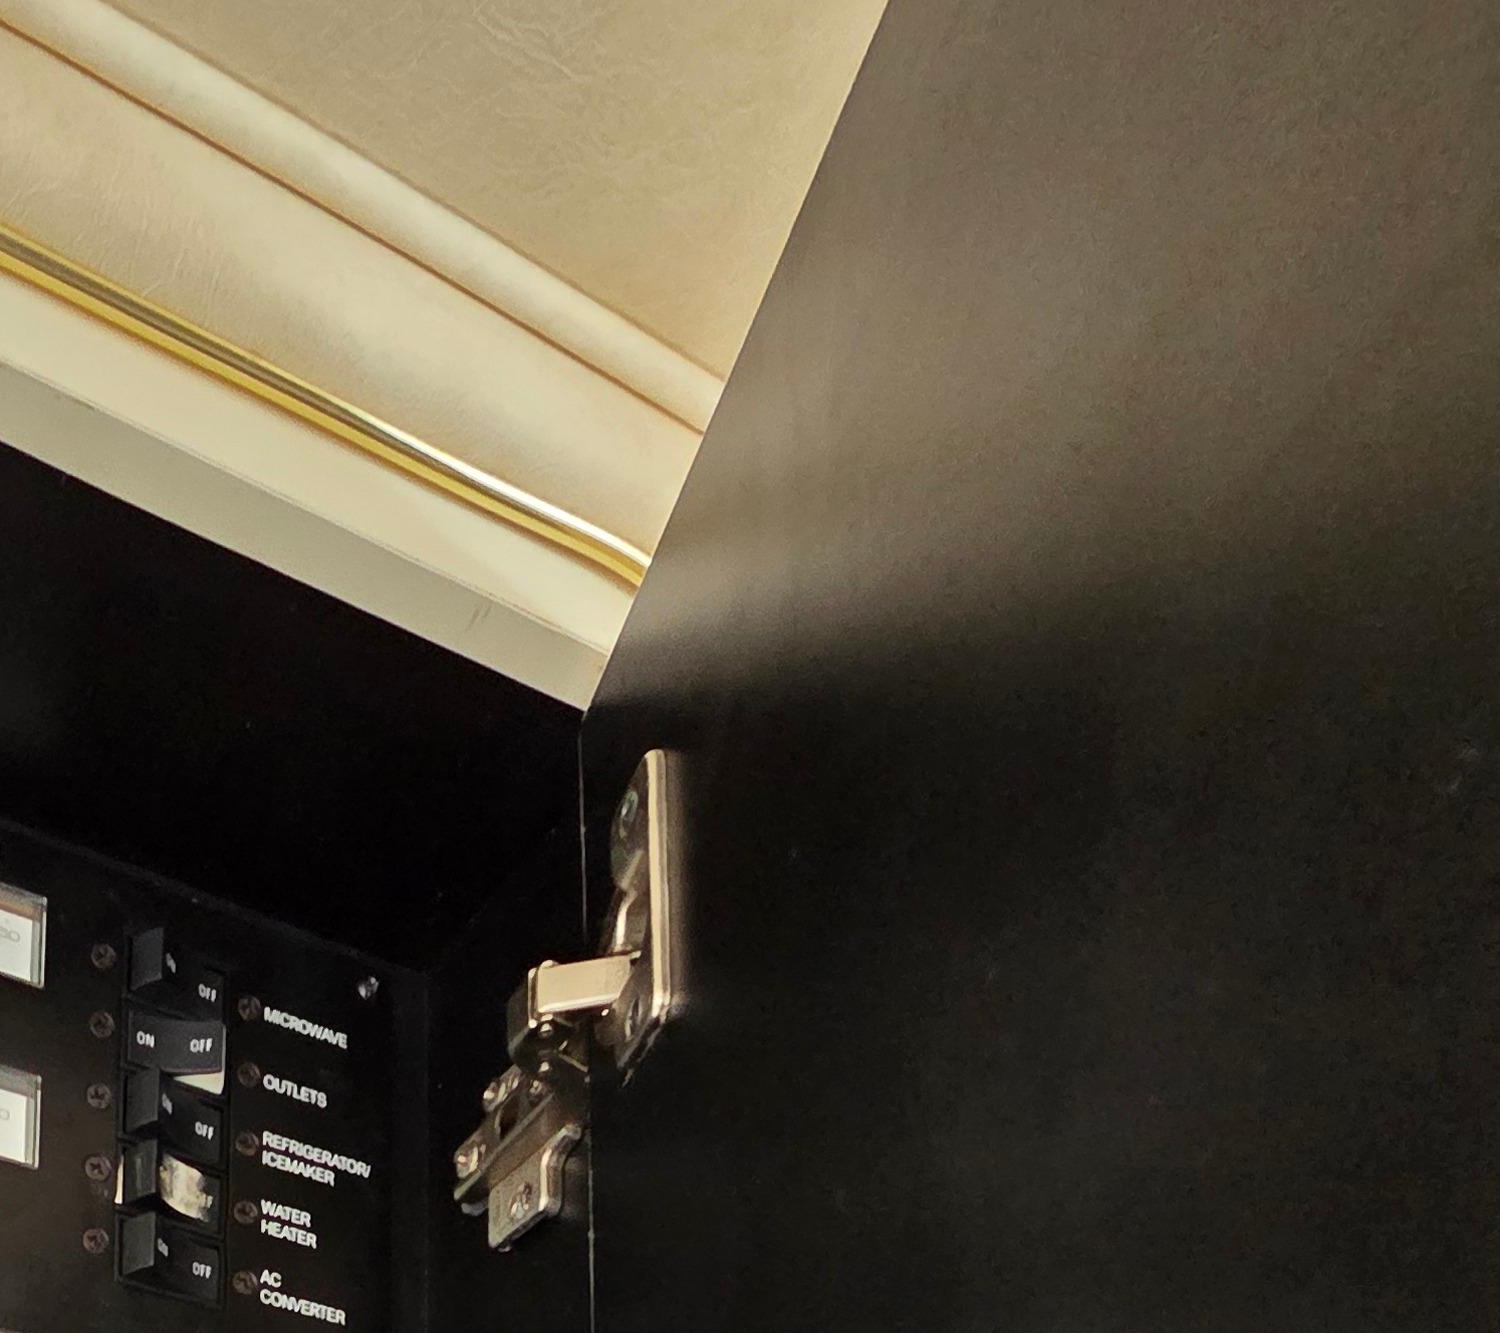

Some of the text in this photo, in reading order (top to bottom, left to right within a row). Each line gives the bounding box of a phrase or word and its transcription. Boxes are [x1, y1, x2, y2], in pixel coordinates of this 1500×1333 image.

[264, 1007, 347, 1049] MICROWAVE
[263, 1074, 327, 1108] OUTLETS
[262, 1152, 334, 1186] ICEMAKER
[263, 1131, 371, 1178] REFRIGERATOR/
[261, 1200, 311, 1227] WATER
[261, 1219, 316, 1249] HEATER
[260, 1271, 281, 1287] AC
[260, 1289, 345, 1325] CONVERTER
